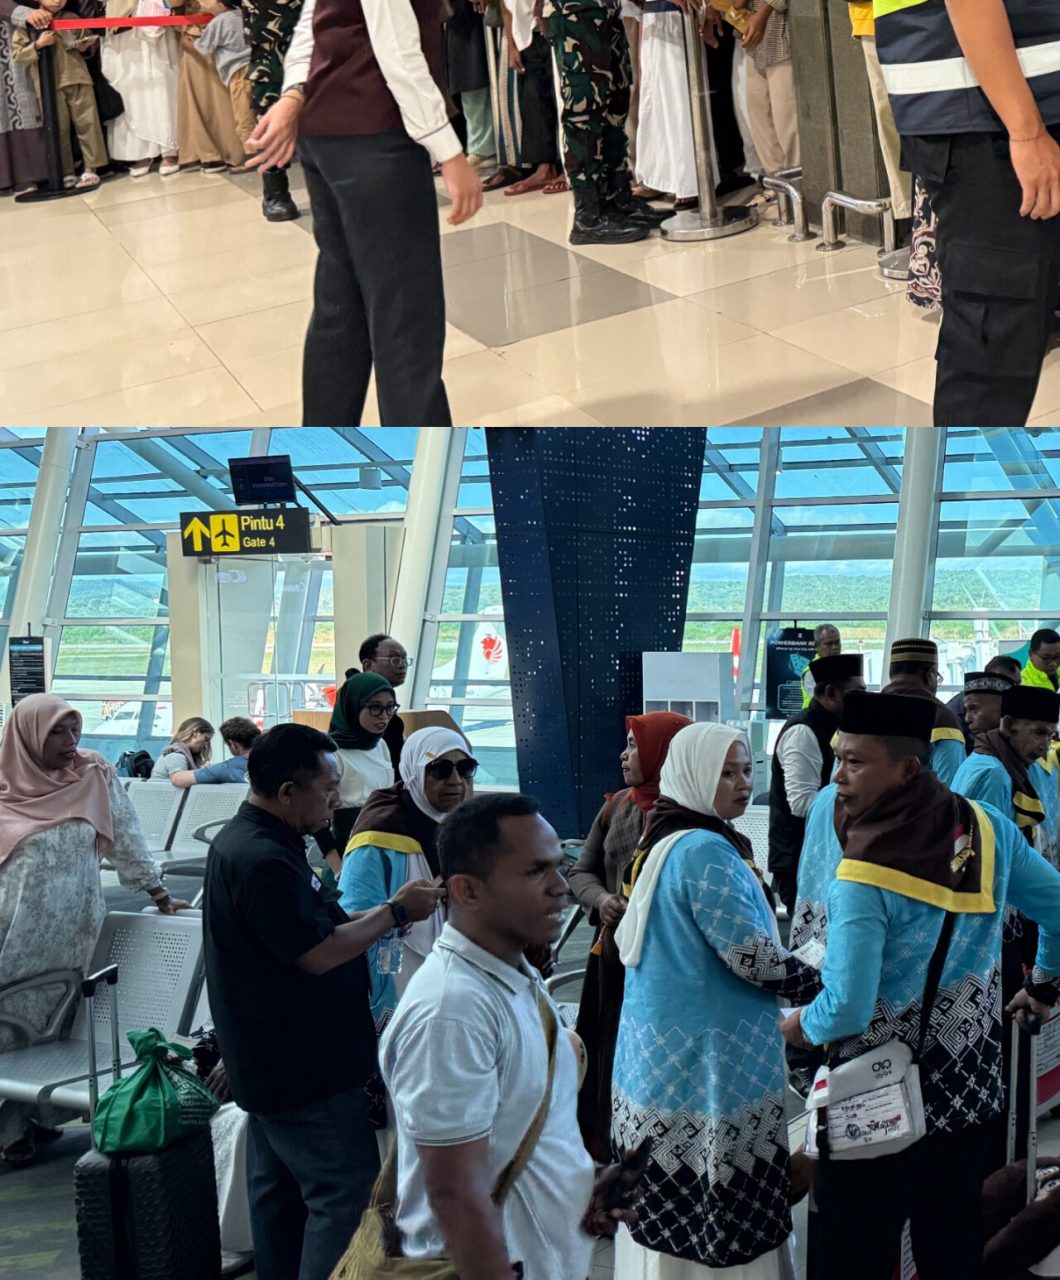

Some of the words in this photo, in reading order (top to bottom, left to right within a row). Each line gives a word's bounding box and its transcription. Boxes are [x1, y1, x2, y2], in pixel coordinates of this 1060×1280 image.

[240, 515, 274, 531] Pintu
[275, 514, 285, 529] 4
[242, 536, 267, 548] Gate
[268, 536, 276, 547] 4
